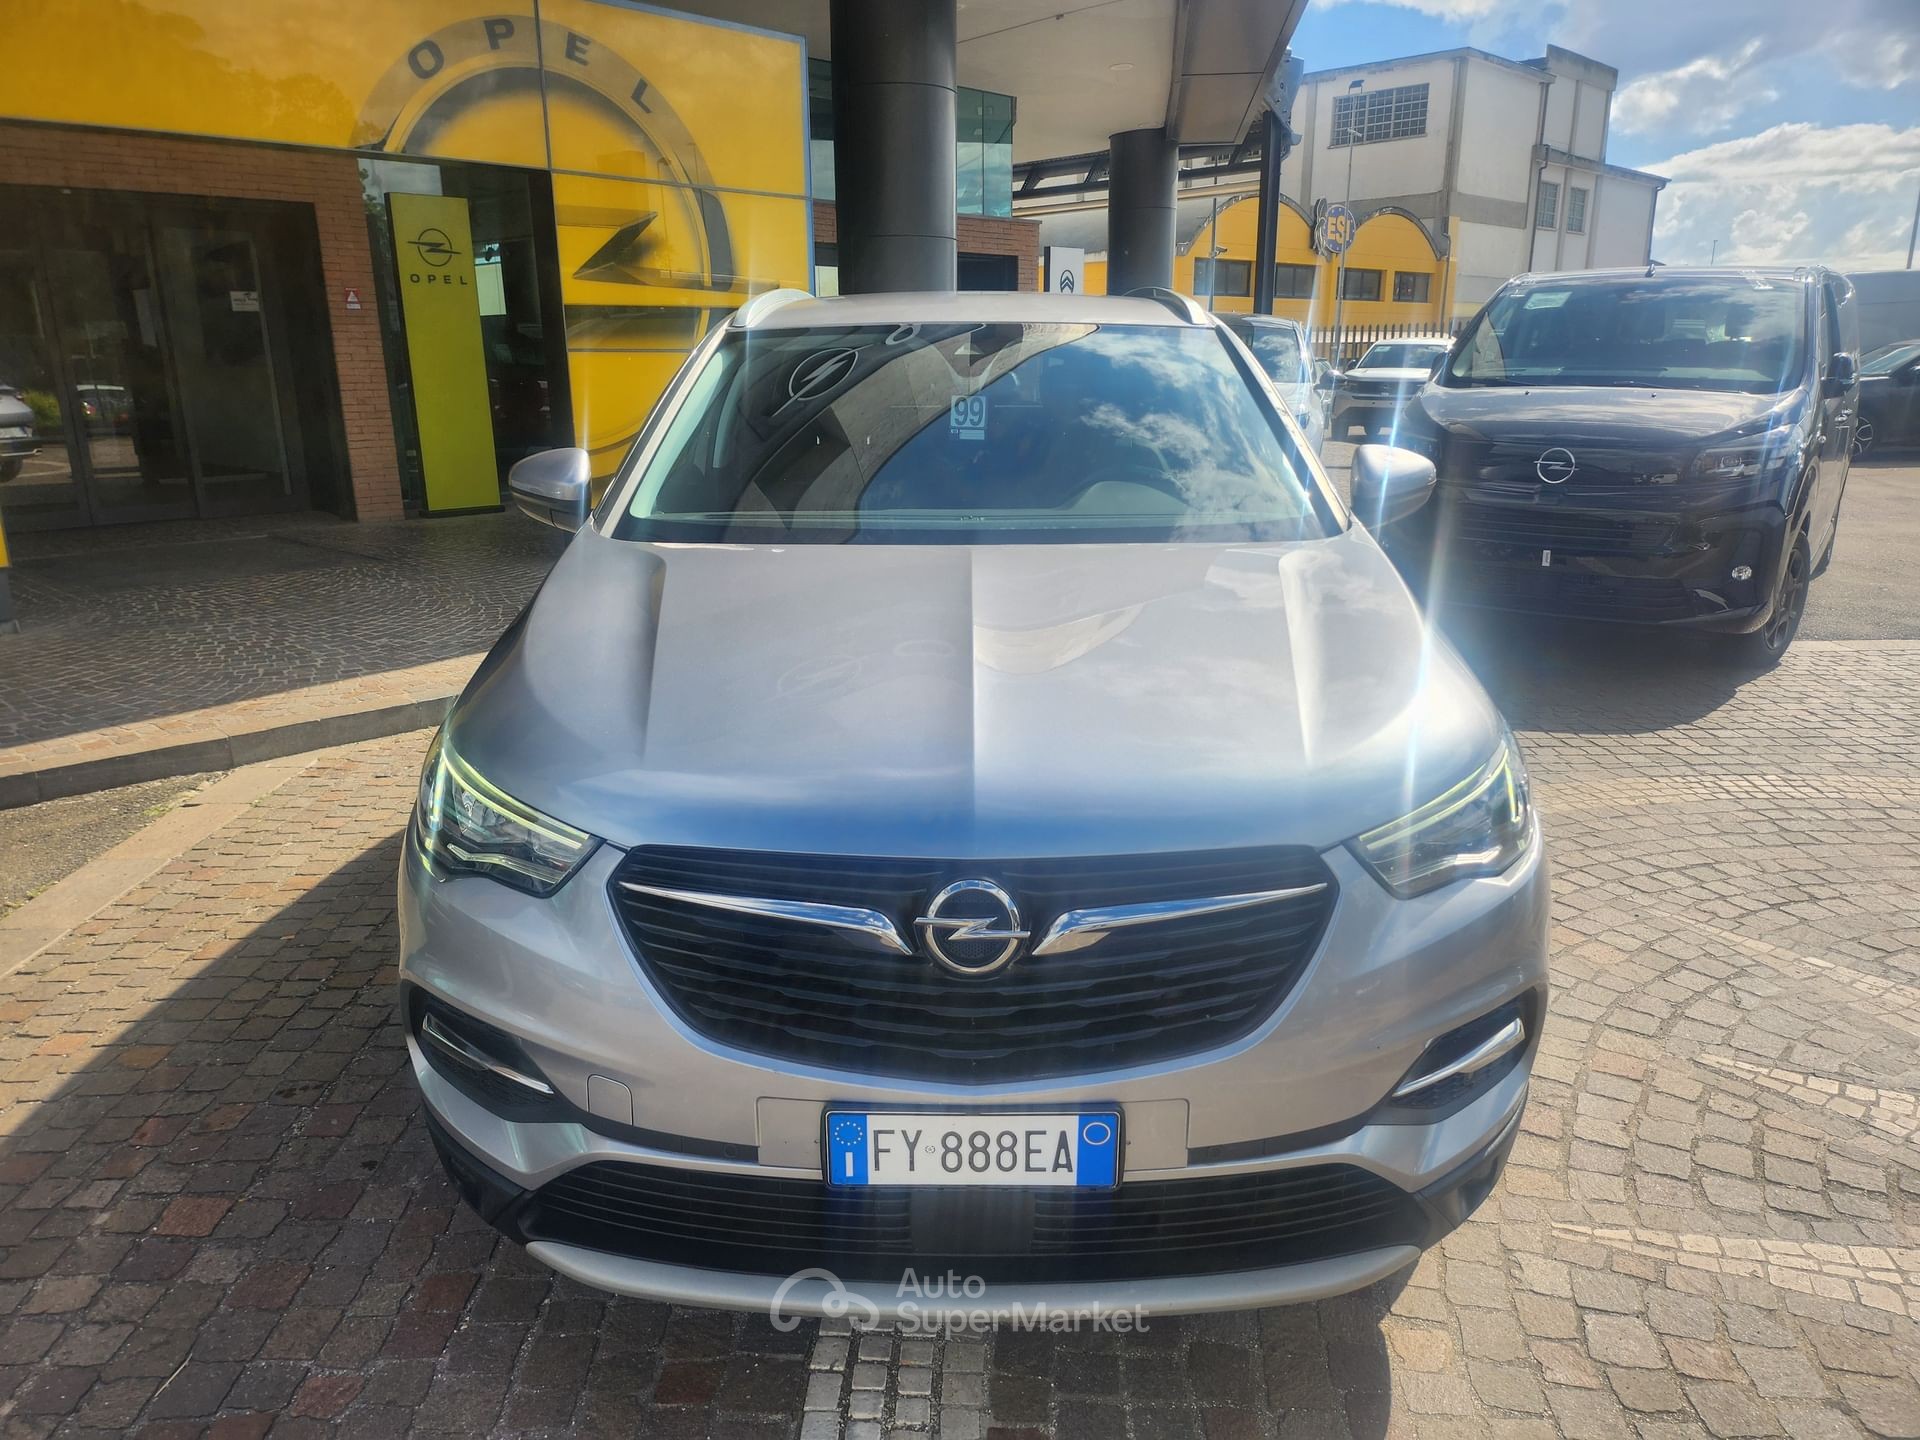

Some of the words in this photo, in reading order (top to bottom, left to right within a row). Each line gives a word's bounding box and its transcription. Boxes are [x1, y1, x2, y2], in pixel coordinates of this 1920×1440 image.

[407, 18, 653, 114] OPEL
[409, 273, 468, 286] OPEL
[954, 396, 984, 426] 99
[872, 1129, 923, 1172] FY
[940, 1130, 1074, 1173] 888EA
